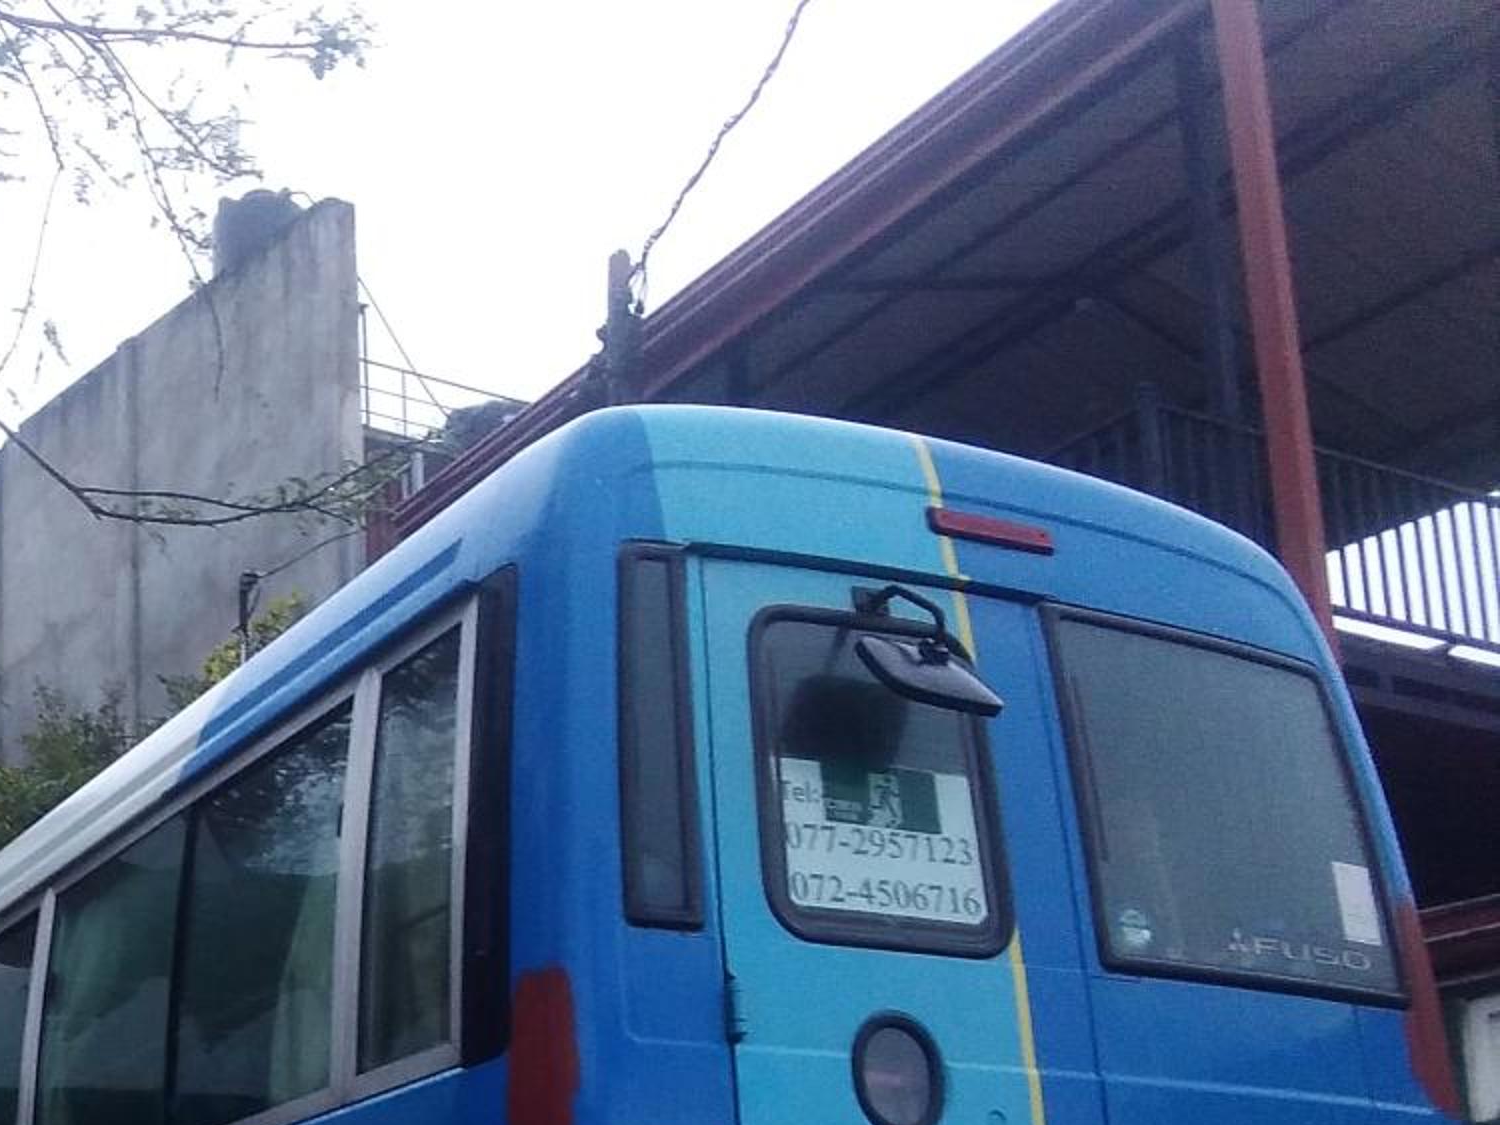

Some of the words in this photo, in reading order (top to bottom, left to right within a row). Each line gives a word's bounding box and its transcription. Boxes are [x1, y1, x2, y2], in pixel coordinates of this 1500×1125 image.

[787, 822, 974, 867] 077-2957123
[790, 869, 982, 916] 072-4506716
[1253, 935, 1373, 972] FUSO
